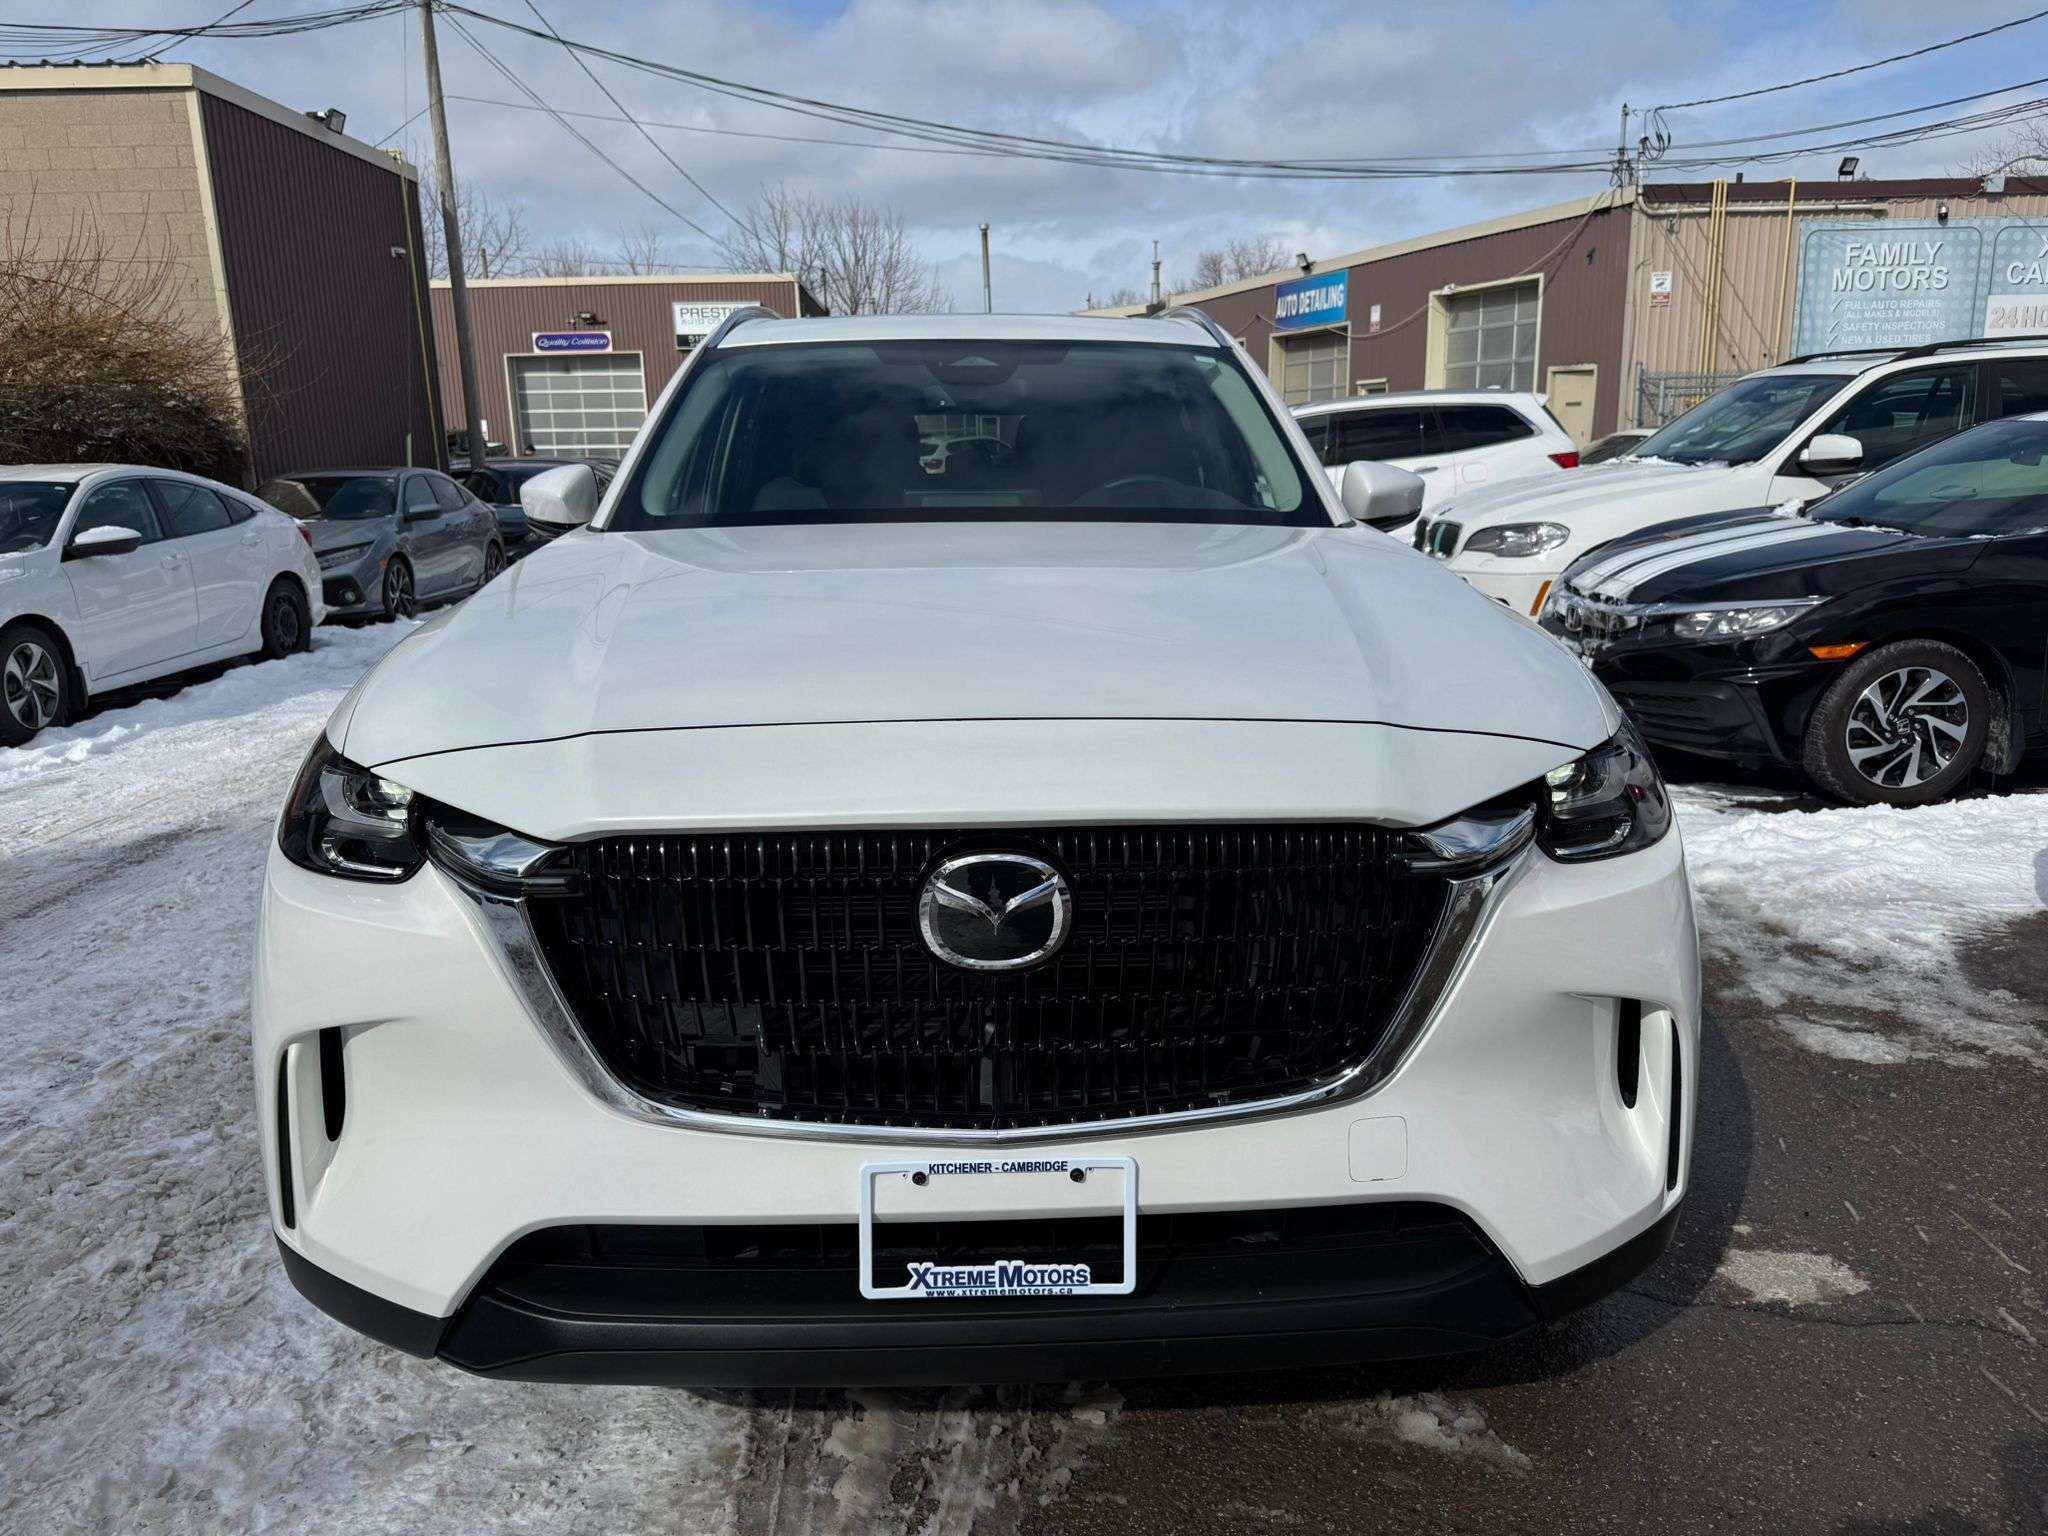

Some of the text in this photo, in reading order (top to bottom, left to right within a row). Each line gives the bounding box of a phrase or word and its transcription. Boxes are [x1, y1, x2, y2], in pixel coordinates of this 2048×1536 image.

[1845, 241, 1943, 267] FAMILY
[1832, 266, 1949, 292] MOTORS
[2007, 261, 2048, 285] CA
[1275, 283, 1344, 319] AUTO DETAILING
[1870, 299, 1898, 310] AUTO
[1899, 299, 1941, 309] REPAIRS
[1841, 321, 1879, 332] SAFETY
[538, 336, 608, 348] Quality Collision
[1840, 335, 1864, 345] NEW
[1875, 334, 1901, 344] USED
[1903, 333, 1932, 344] TIRES
[928, 1162, 993, 1175] KITCHENER
[1001, 1160, 1068, 1173] CAMBRIDGE
[925, 1286, 1073, 1297] www.xtrememotors.ca
